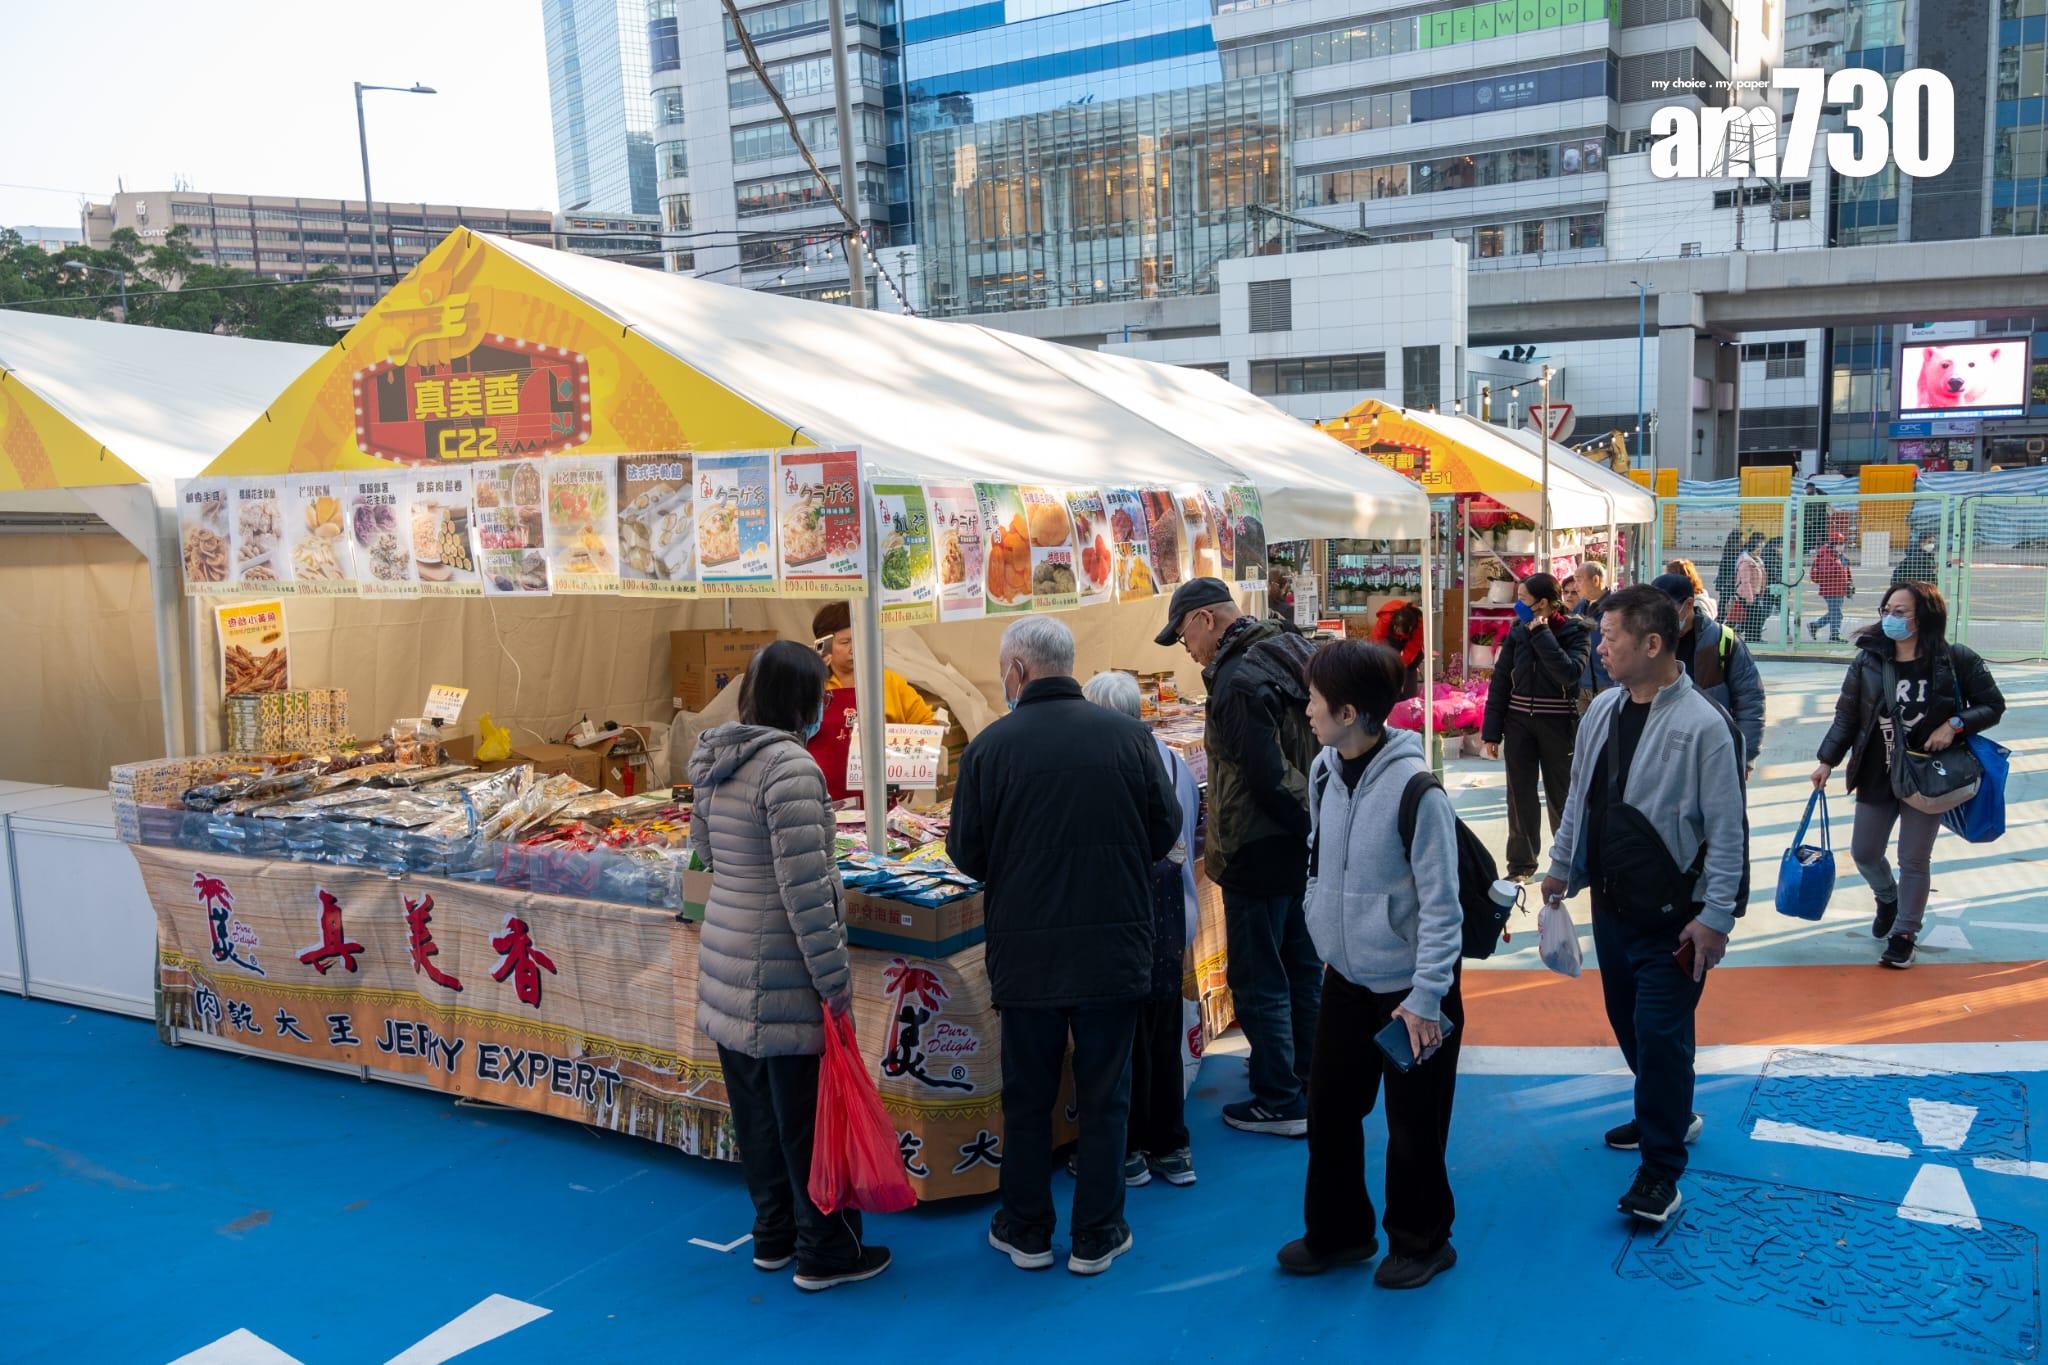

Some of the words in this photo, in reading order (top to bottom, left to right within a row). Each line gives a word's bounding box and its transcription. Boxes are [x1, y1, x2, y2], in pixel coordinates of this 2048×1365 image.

[414, 373, 520, 420] 真美香
[438, 426, 498, 459] C22
[1367, 453, 1415, 469] 策劃
[234, 921, 252, 934] Pure
[232, 932, 258, 947] Delight
[299, 889, 557, 1009] 真美香
[936, 1023, 969, 1038] Pure
[927, 1038, 978, 1057] Delight
[477, 1042, 622, 1106] EXPERT
